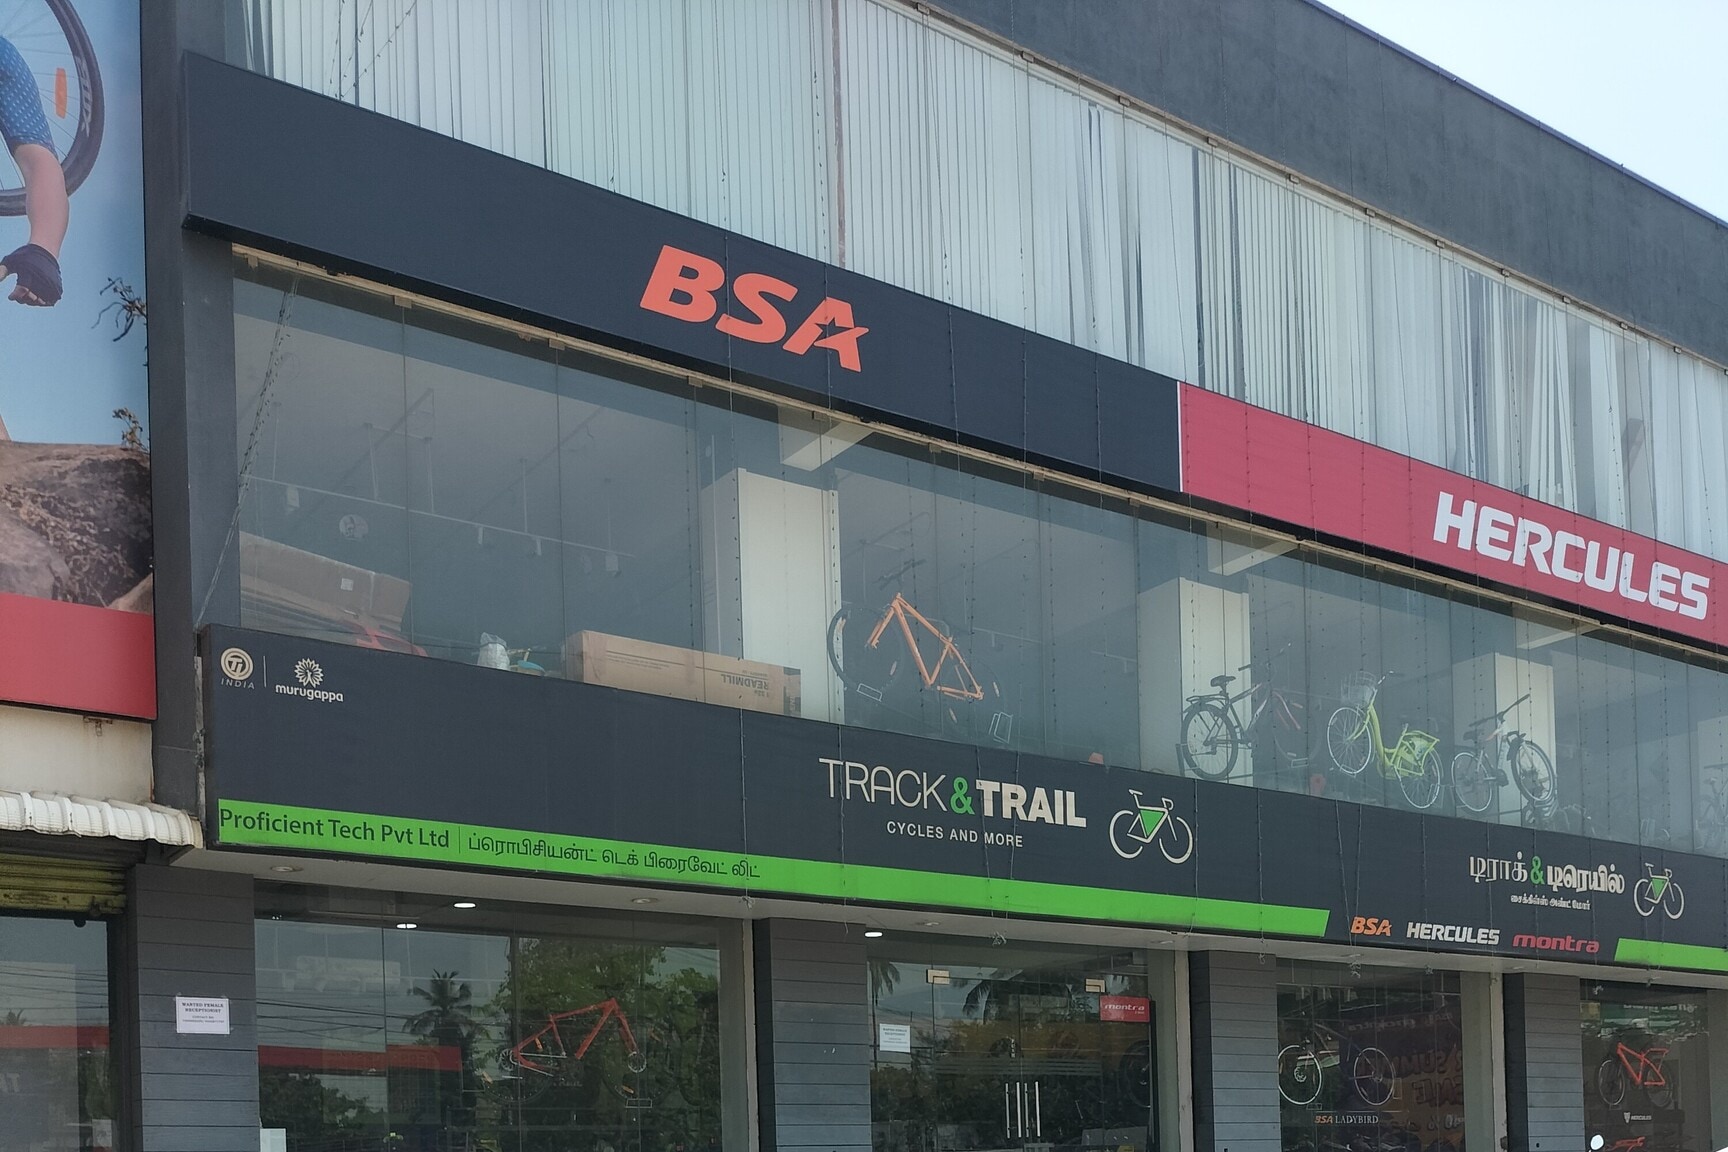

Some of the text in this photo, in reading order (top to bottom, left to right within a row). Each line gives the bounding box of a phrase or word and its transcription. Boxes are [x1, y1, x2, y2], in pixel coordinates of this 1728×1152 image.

[639, 244, 869, 373] BSA
[1433, 491, 1710, 620] HERCULES
[221, 679, 255, 690] INDIA
[720, 673, 769, 691] READMILL
[275, 684, 344, 703] murugappa
[219, 808, 449, 848] Proficient Tech Pvt Ltd
[886, 821, 1024, 848] CYCLES AND MORE
[601, 848, 640, 867] டெக்
[643, 851, 728, 874] பிரைவேட்
[1350, 916, 1393, 937] BSA
[1406, 921, 1500, 946] HERCULES
[1512, 933, 1600, 954] montra
[1104, 1003, 1145, 1011] montra
[1335, 1115, 1379, 1124] LADYBIRD
